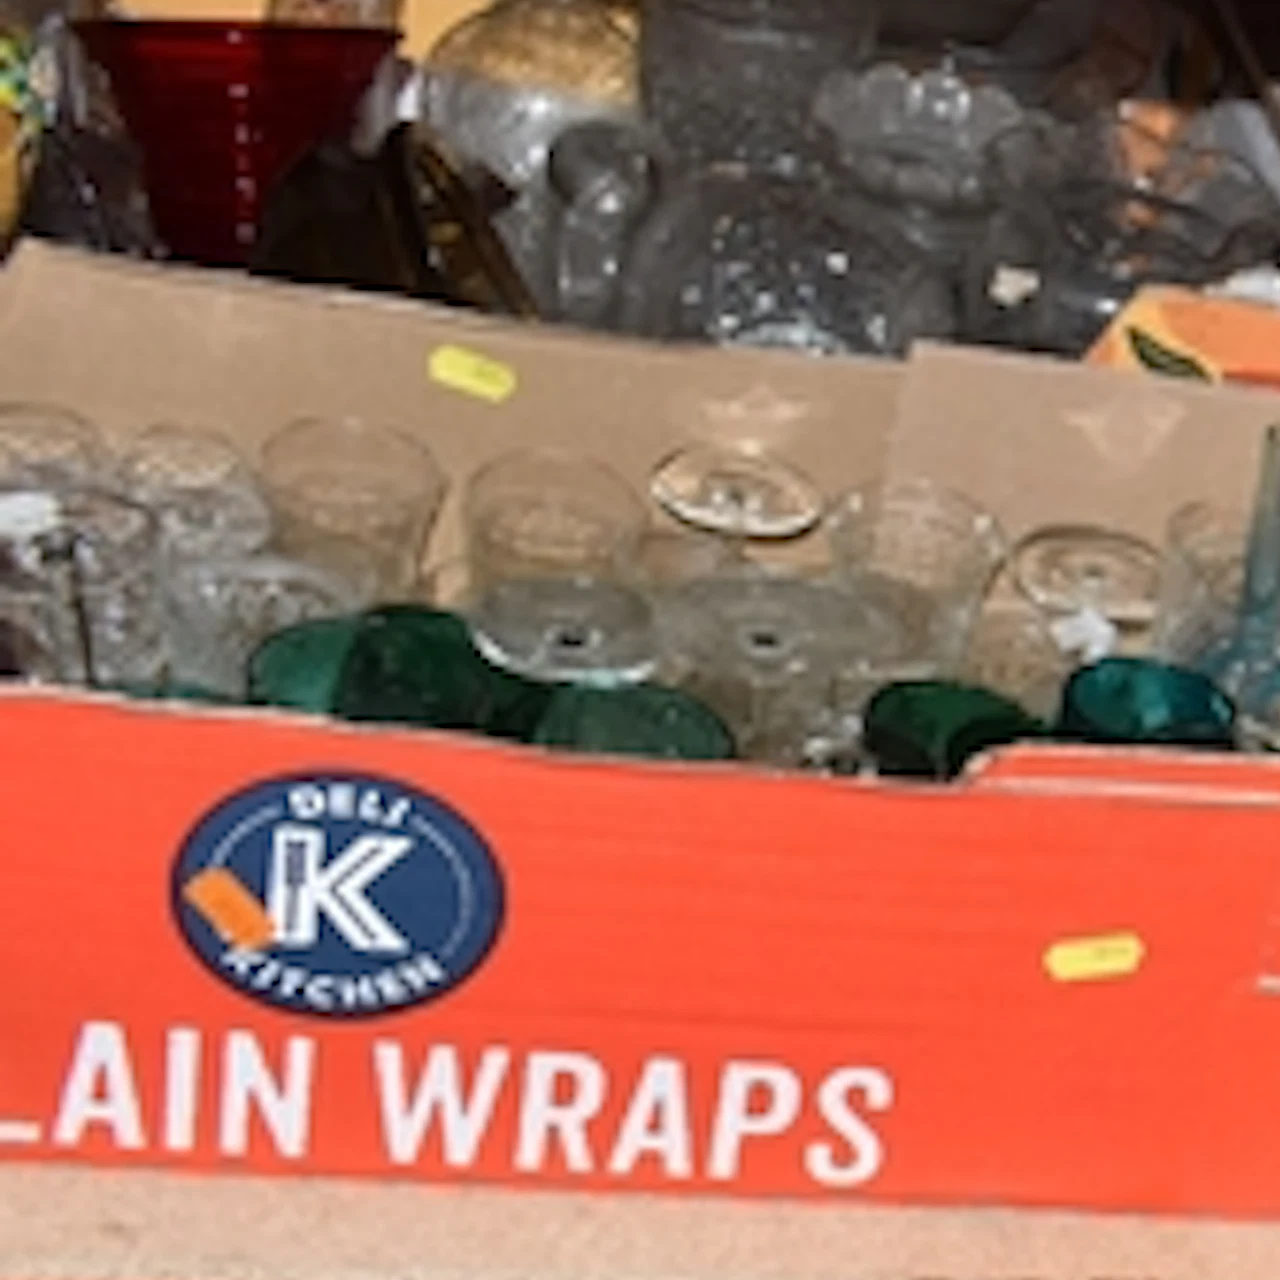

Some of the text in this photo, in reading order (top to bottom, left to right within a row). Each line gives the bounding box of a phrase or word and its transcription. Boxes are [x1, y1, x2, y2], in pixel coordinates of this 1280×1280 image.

[287, 783, 411, 830] DELI
[263, 826, 412, 952] K
[221, 946, 445, 1011] KITCHEN
[0, 1021, 315, 1159] AIN
[373, 1039, 894, 1188] WRAPS
